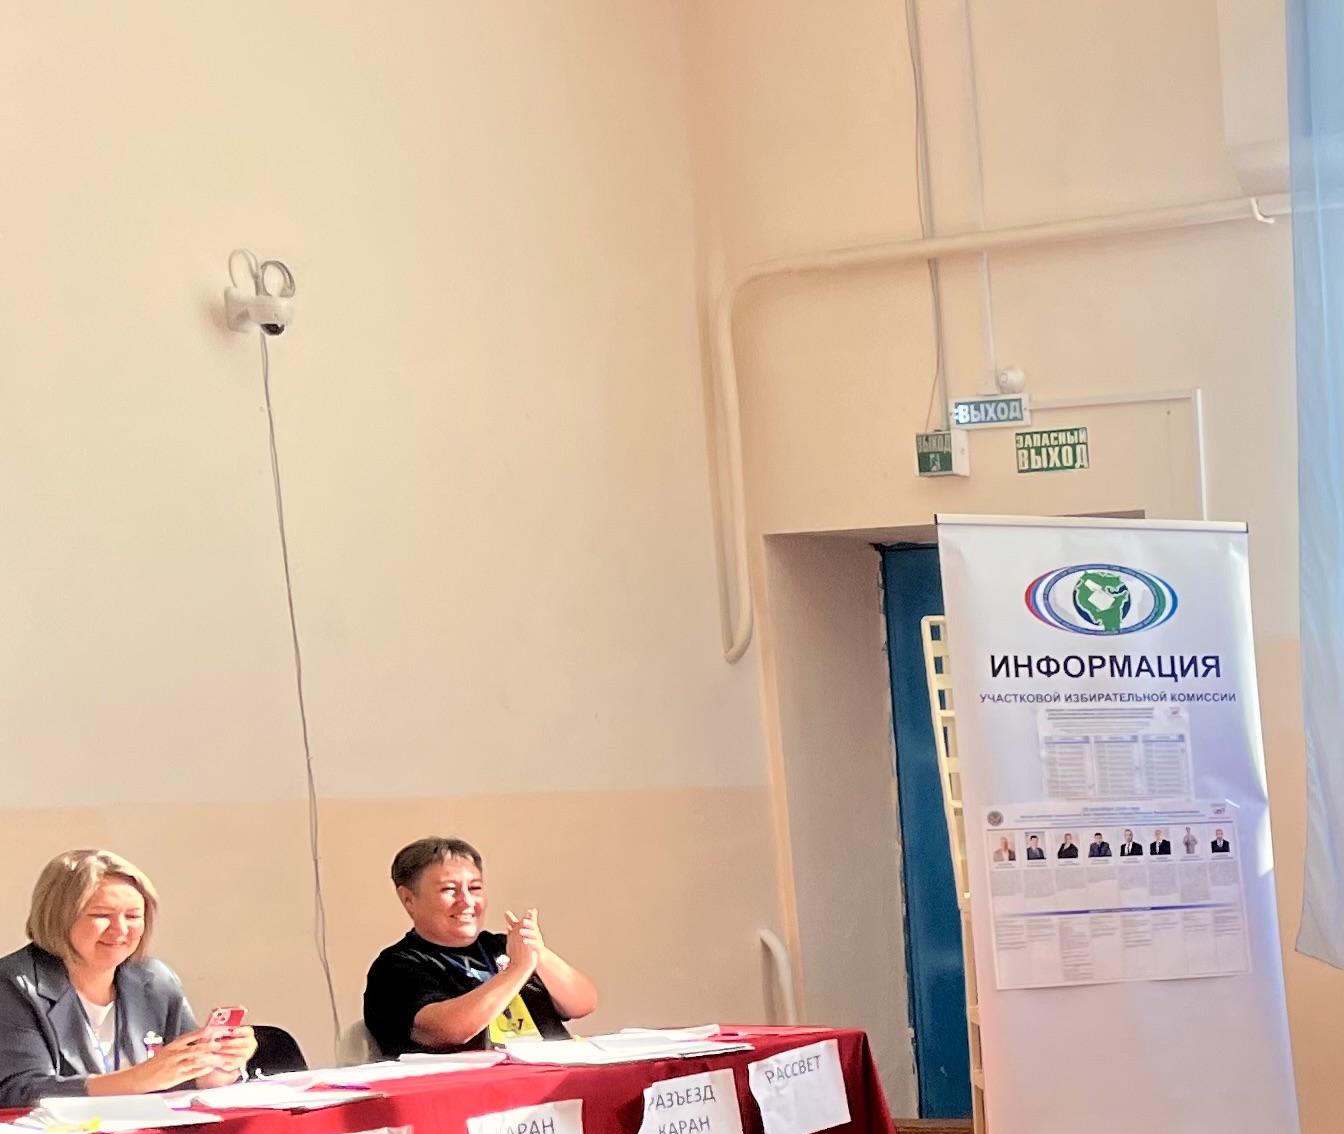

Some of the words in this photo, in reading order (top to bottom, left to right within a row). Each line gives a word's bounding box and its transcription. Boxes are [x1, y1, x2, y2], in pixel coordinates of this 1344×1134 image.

[957, 400, 1021, 424] ВЫХОД
[1015, 427, 1087, 448] ЗАПАСНЫЙ
[1017, 444, 1089, 470] ВЫХОД
[990, 654, 1221, 682] ИНФОРМАЦИЯ
[980, 691, 1061, 704] УЧАСТКОВОЙ
[1066, 691, 1167, 703] ИЗБИРАТЕЛЬНОЙ
[1170, 692, 1237, 703] КОМИССИИ
[765, 1055, 821, 1084] РАССВЕТ
